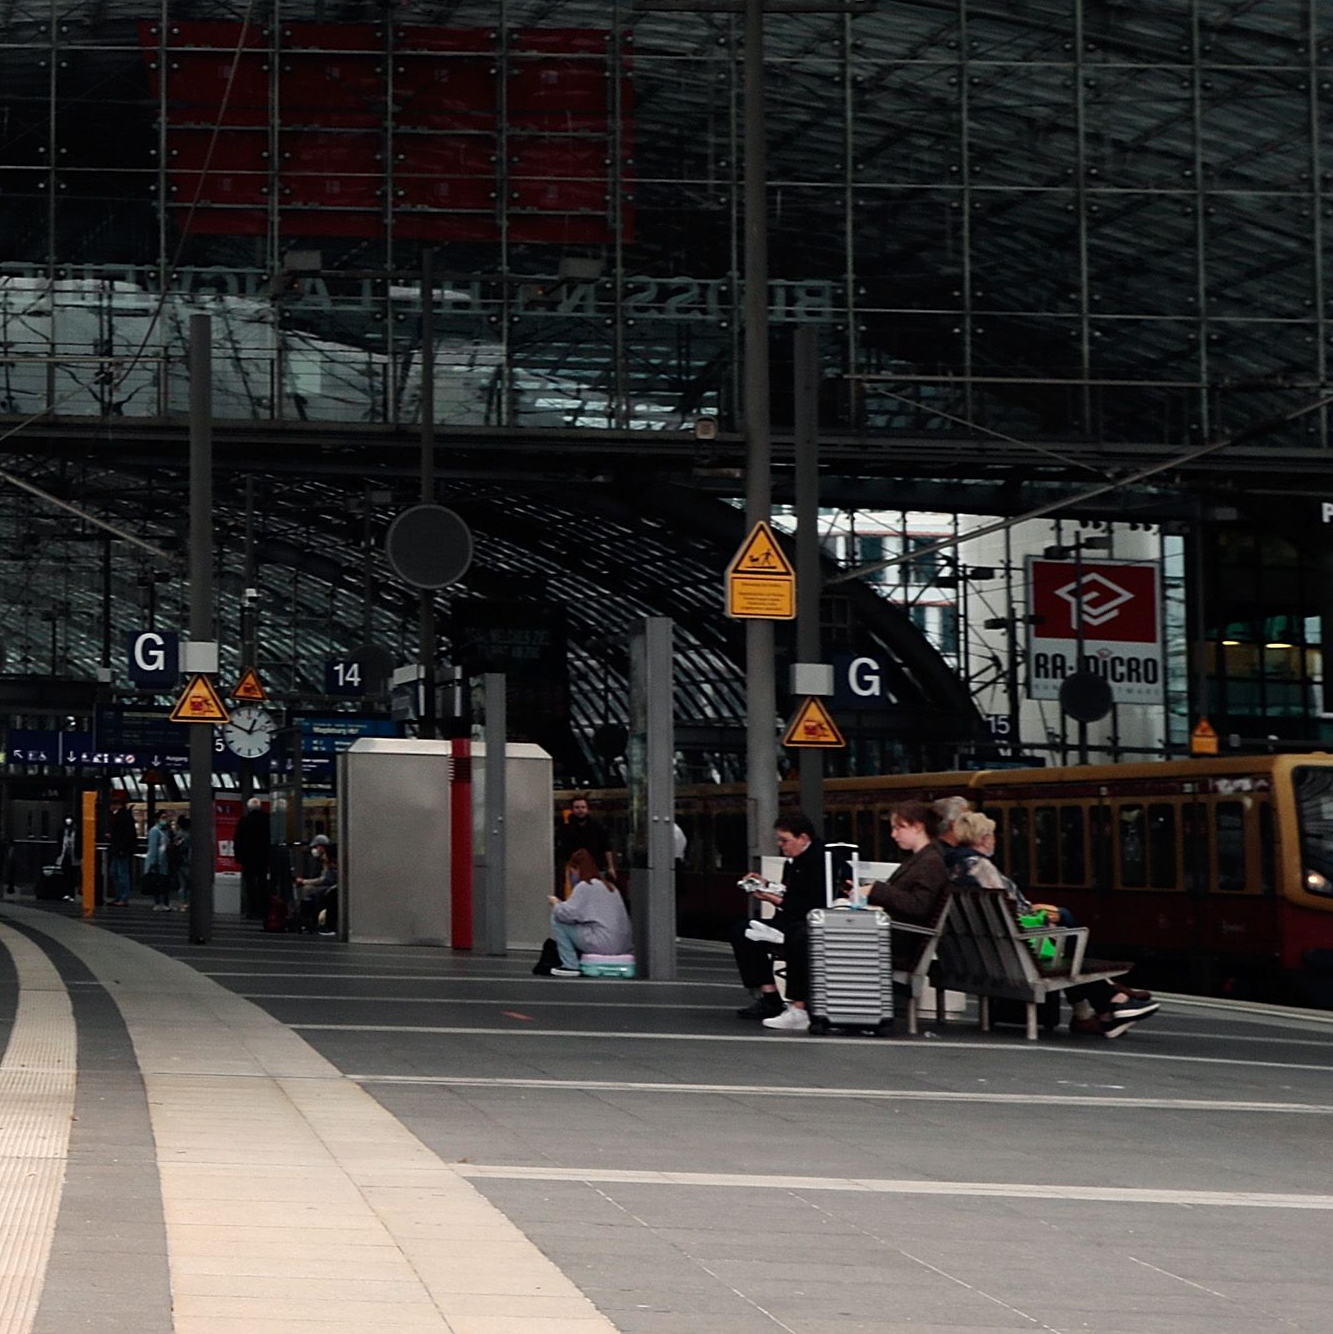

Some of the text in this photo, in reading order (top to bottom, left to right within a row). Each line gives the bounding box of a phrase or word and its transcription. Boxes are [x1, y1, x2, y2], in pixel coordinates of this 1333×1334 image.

[134, 633, 165, 671] G
[333, 663, 361, 687] 14
[847, 656, 882, 697] G
[987, 715, 1011, 734] 15
